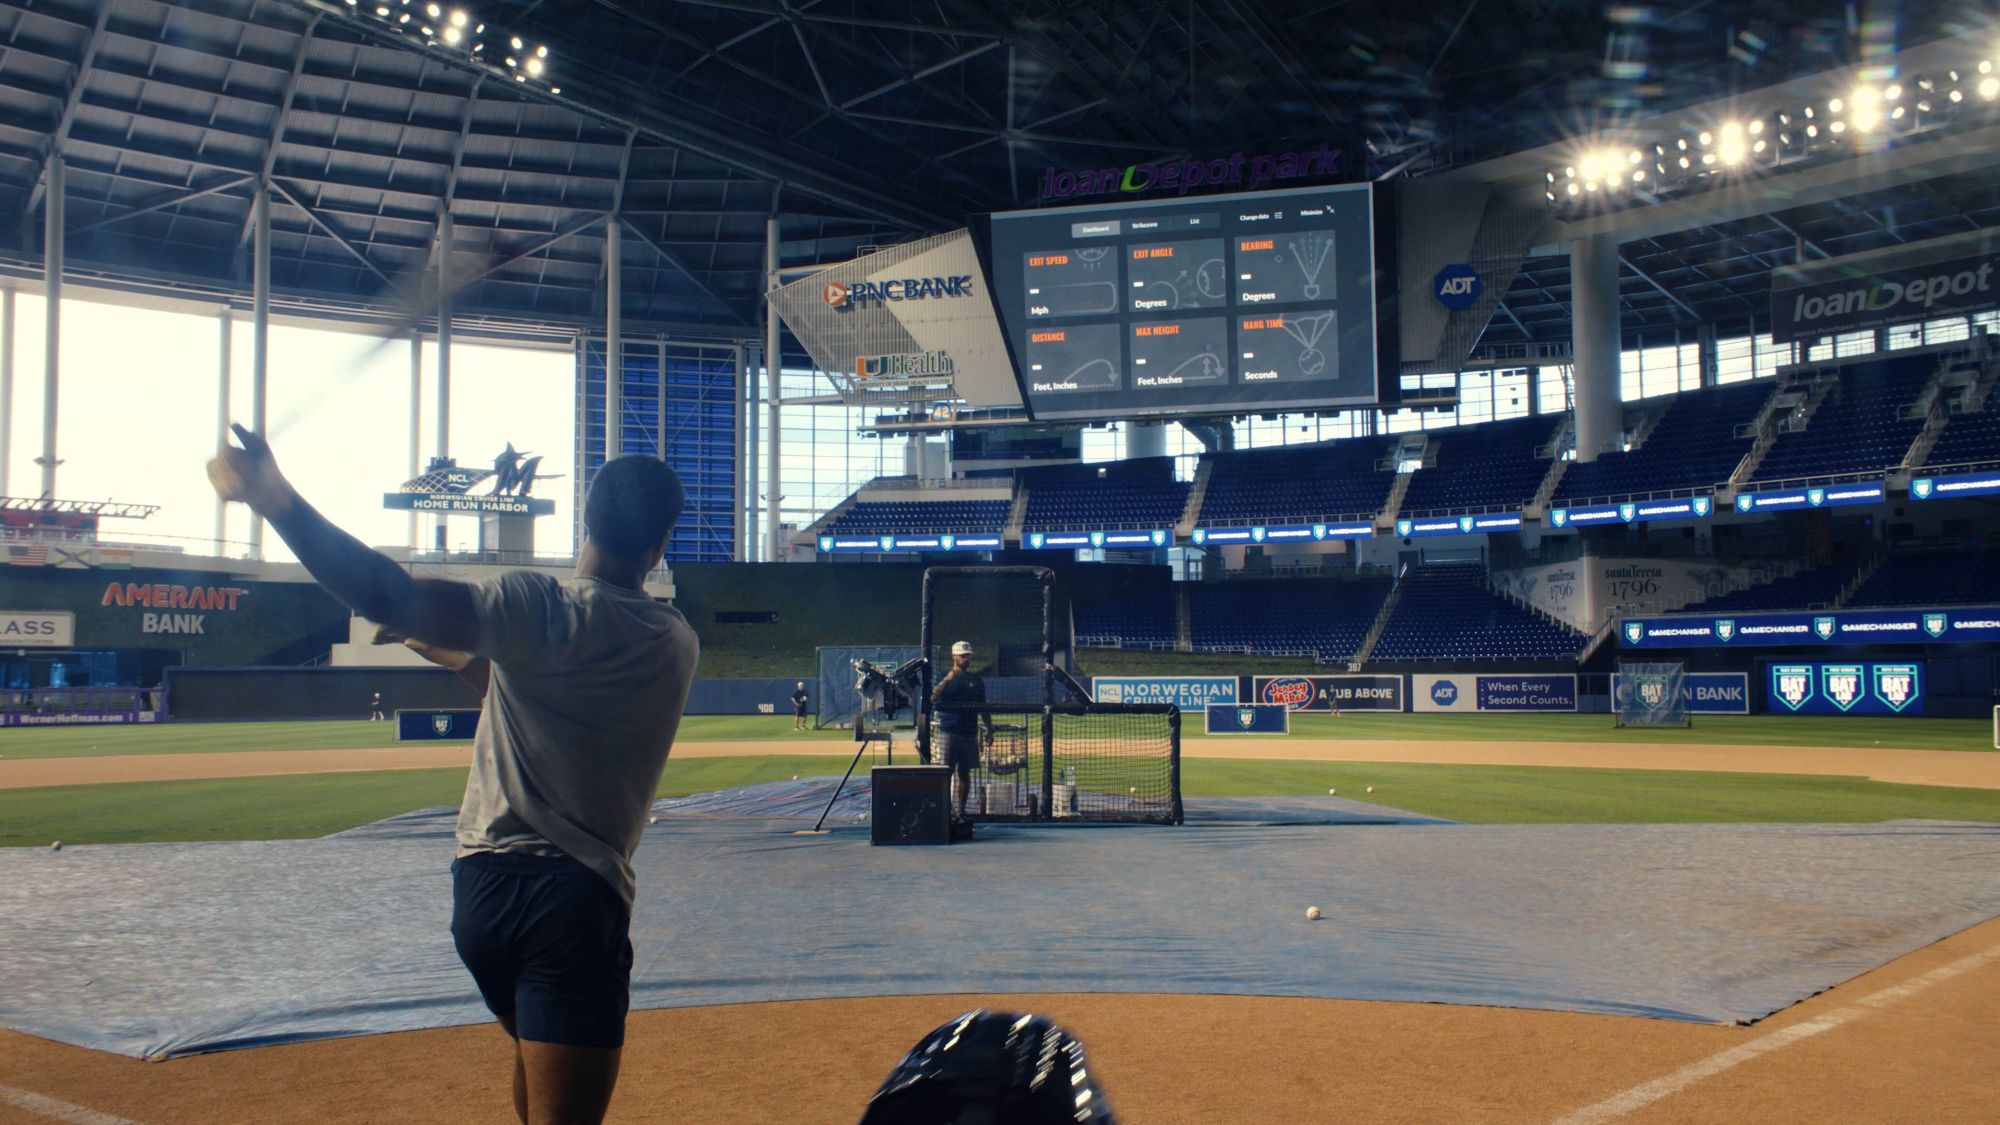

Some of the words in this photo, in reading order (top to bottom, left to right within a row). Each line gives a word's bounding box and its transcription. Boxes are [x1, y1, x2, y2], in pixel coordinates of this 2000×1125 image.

[1043, 152, 1245, 199] loanDepot
[1250, 144, 1341, 189] park
[1241, 240, 1274, 251] BEARING
[1133, 249, 1149, 259] EXIT
[1150, 248, 1174, 258] ANGLE
[1029, 257, 1044, 266] EXIT
[1046, 255, 1068, 265] SPEED
[1440, 277, 1476, 295] ADT
[1793, 262, 1993, 322] loanDepot
[1242, 293, 1276, 302] Degrees
[1135, 300, 1167, 309] Degrees
[1031, 306, 1049, 316] Mph
[1243, 320, 1264, 330] HANG
[1266, 318, 1284, 328] TIME
[1136, 327, 1152, 336] MAX
[1153, 325, 1180, 335] HEIGHT
[1032, 332, 1065, 343] DISTANCE
[1138, 377, 1157, 386] Feet,
[1158, 376, 1183, 385] Inches
[1245, 371, 1278, 380] Seconds
[1033, 382, 1053, 391] Feet,
[1053, 382, 1078, 390] Inches
[934, 405, 950, 418] 42
[448, 474, 469, 483] NCL
[413, 499, 449, 509] HOME
[454, 500, 478, 510] RUN
[482, 501, 528, 512] HARBOR
[102, 582, 242, 610] AMERANT
[0, 621, 56, 635] ASS
[143, 613, 205, 634] BANK
[1648, 628, 1710, 636] GAMECHANGER
[1741, 625, 1808, 634] GAMECHANGER
[1841, 622, 1917, 632] GAMECHANGER
[1100, 688, 1120, 697] NCL
[1123, 684, 1233, 696] NORWEGIAN
[1269, 682, 1308, 696] Jersey
[1488, 682, 1518, 692] When
[1521, 682, 1550, 694] Every
[1641, 684, 1663, 697] BAT
[1780, 677, 1806, 692] BAT
[1830, 677, 1857, 692] BAT
[1882, 677, 1910, 692] BAT
[1319, 688, 1327, 699] A
[1331, 688, 1352, 699] UB
[1355, 688, 1392, 699] ABOVE
[1434, 688, 1455, 698] ADT
[1697, 687, 1742, 700] BANK
[1123, 696, 1175, 704] CRUISE
[1488, 695, 1526, 705] Second
[1529, 696, 1573, 705] Counts.
[758, 703, 774, 713] 400
